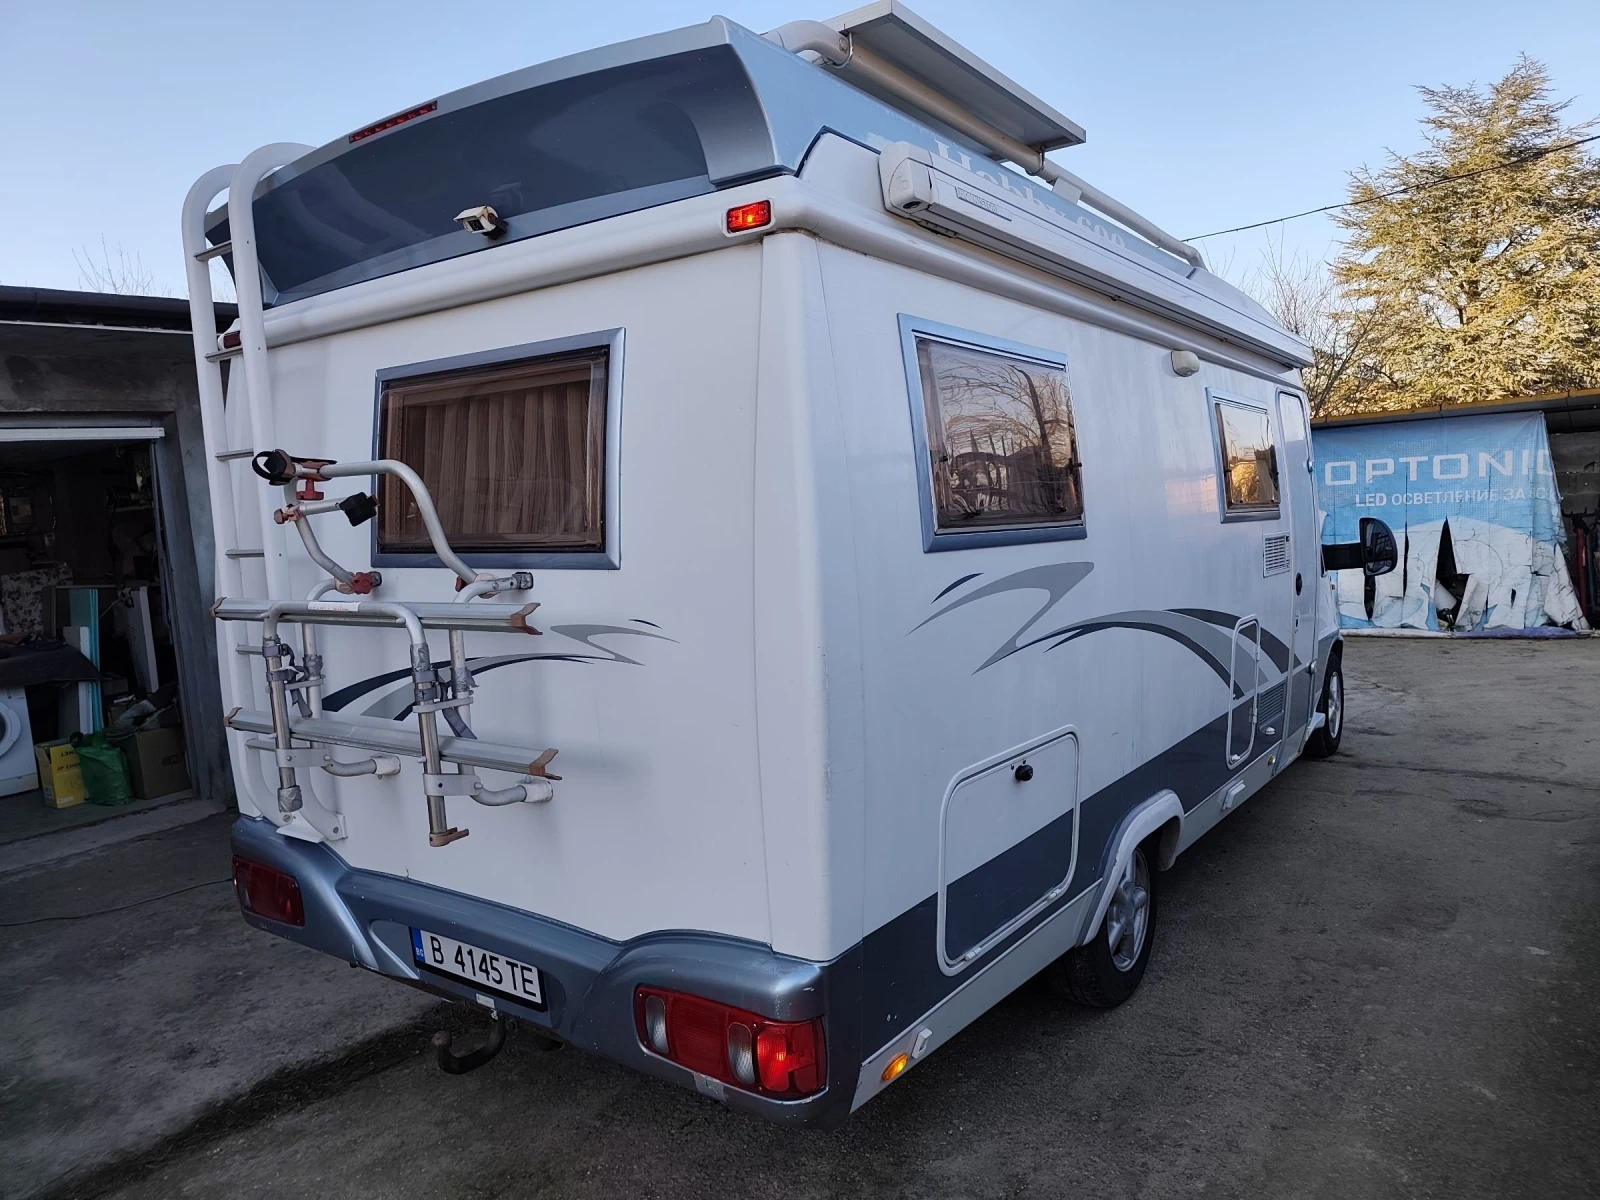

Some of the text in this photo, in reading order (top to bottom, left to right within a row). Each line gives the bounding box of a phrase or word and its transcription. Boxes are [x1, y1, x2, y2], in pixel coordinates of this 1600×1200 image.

[1355, 493, 1387, 507] LED
[1503, 488, 1526, 500] ЗА
[430, 935, 537, 998] B 4145 TE
